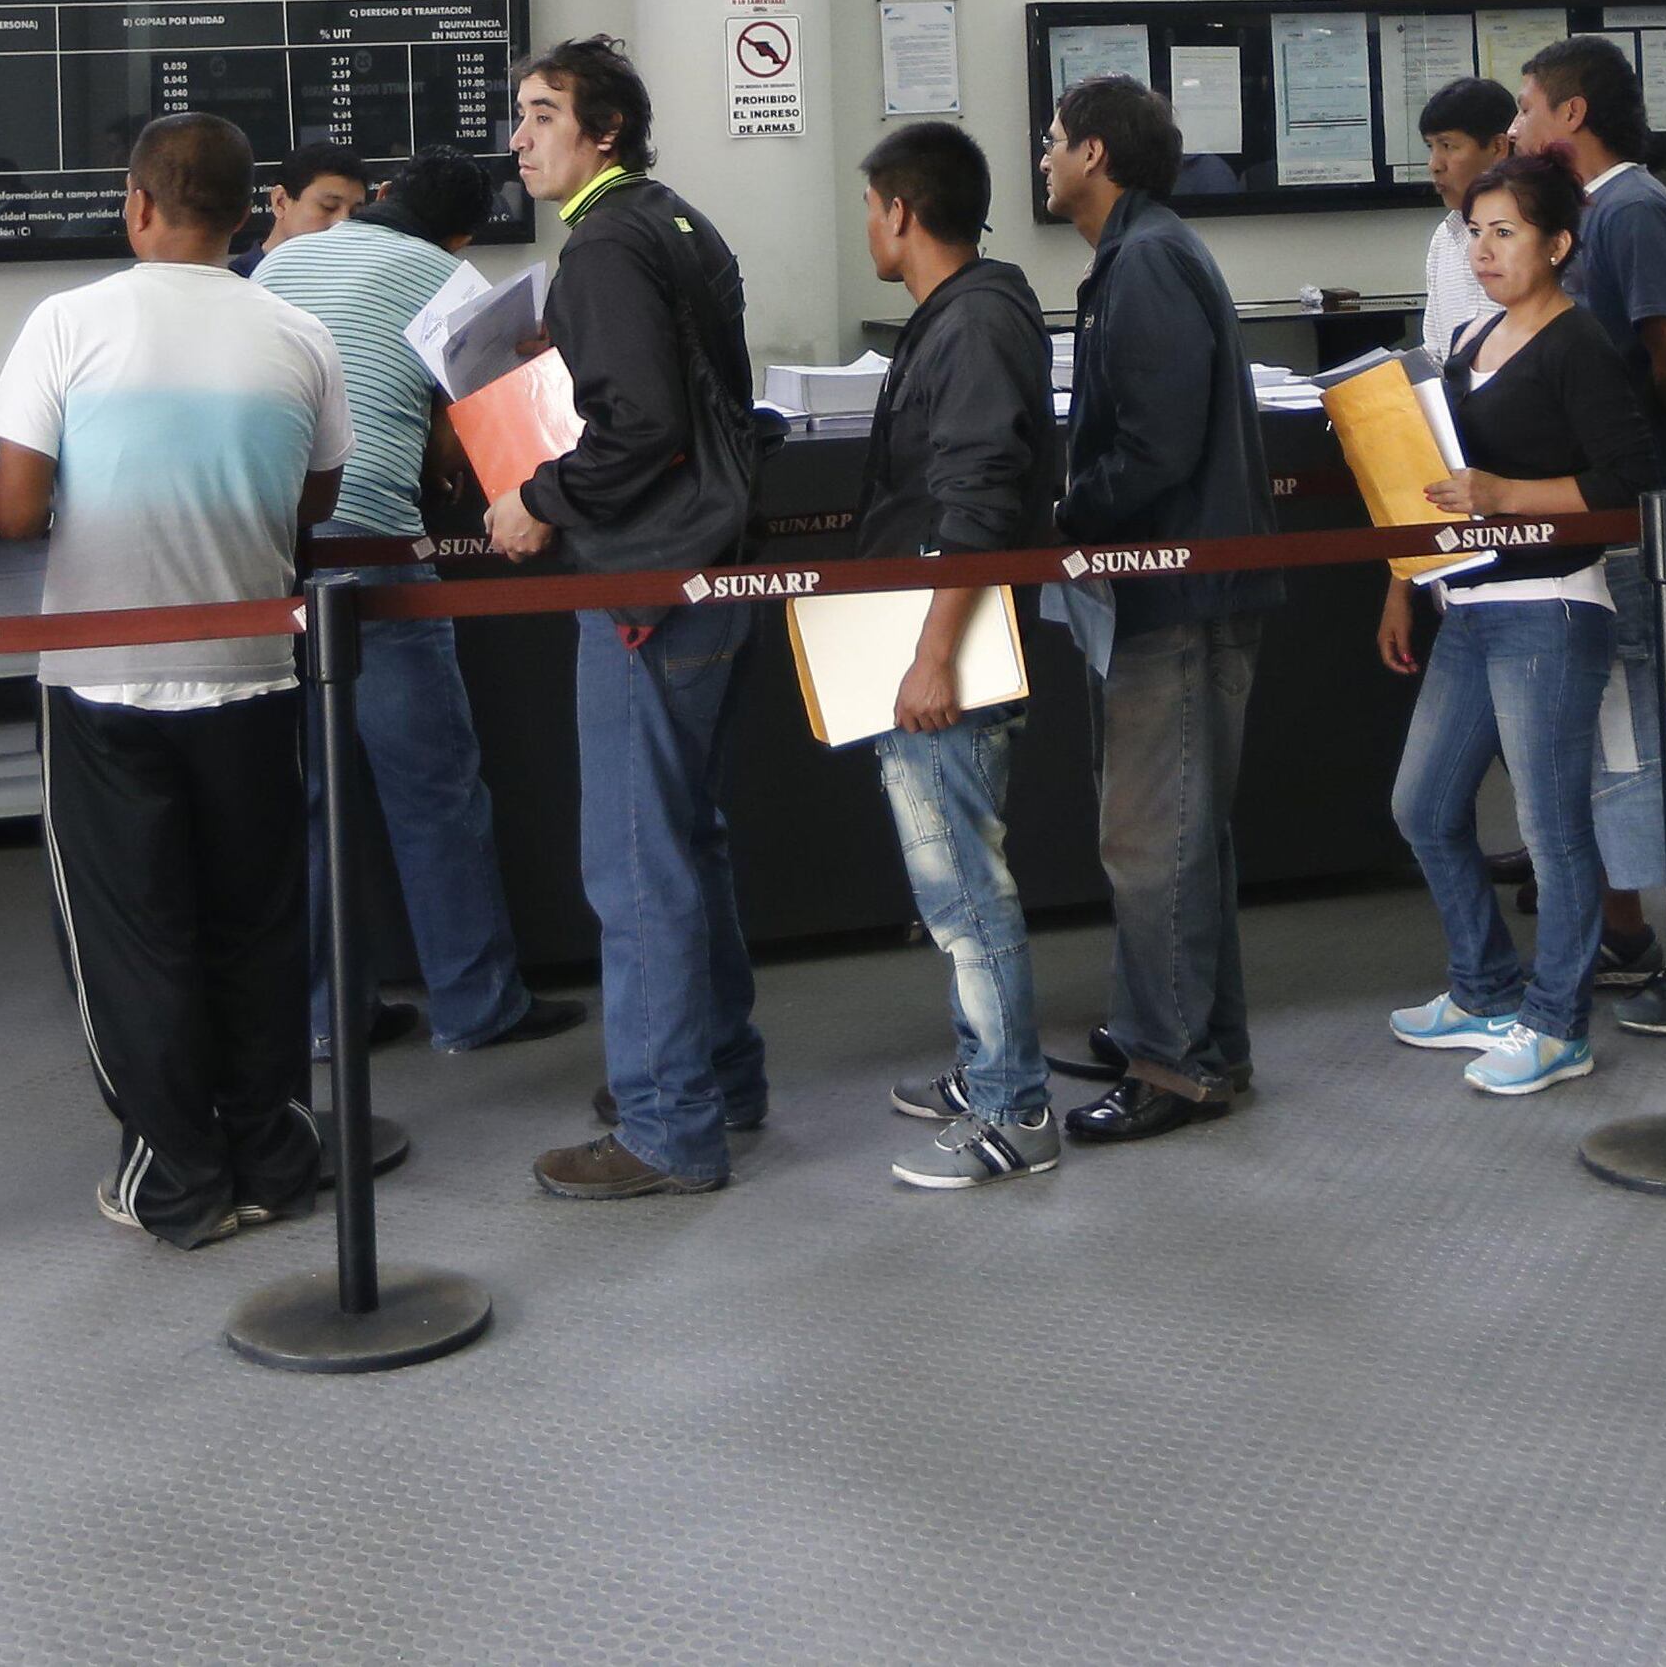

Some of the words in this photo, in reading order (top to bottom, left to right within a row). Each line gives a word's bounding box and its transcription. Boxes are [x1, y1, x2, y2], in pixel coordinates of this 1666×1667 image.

[735, 94, 797, 105] PROHIBIDO
[733, 108, 749, 119] EL
[753, 107, 800, 119] INGRESO
[739, 123, 754, 134] DE
[757, 122, 796, 134] ARMAS
[1462, 523, 1554, 547] SUNARP
[1092, 548, 1189, 573] SUNARP
[714, 571, 819, 598] SUNARP
